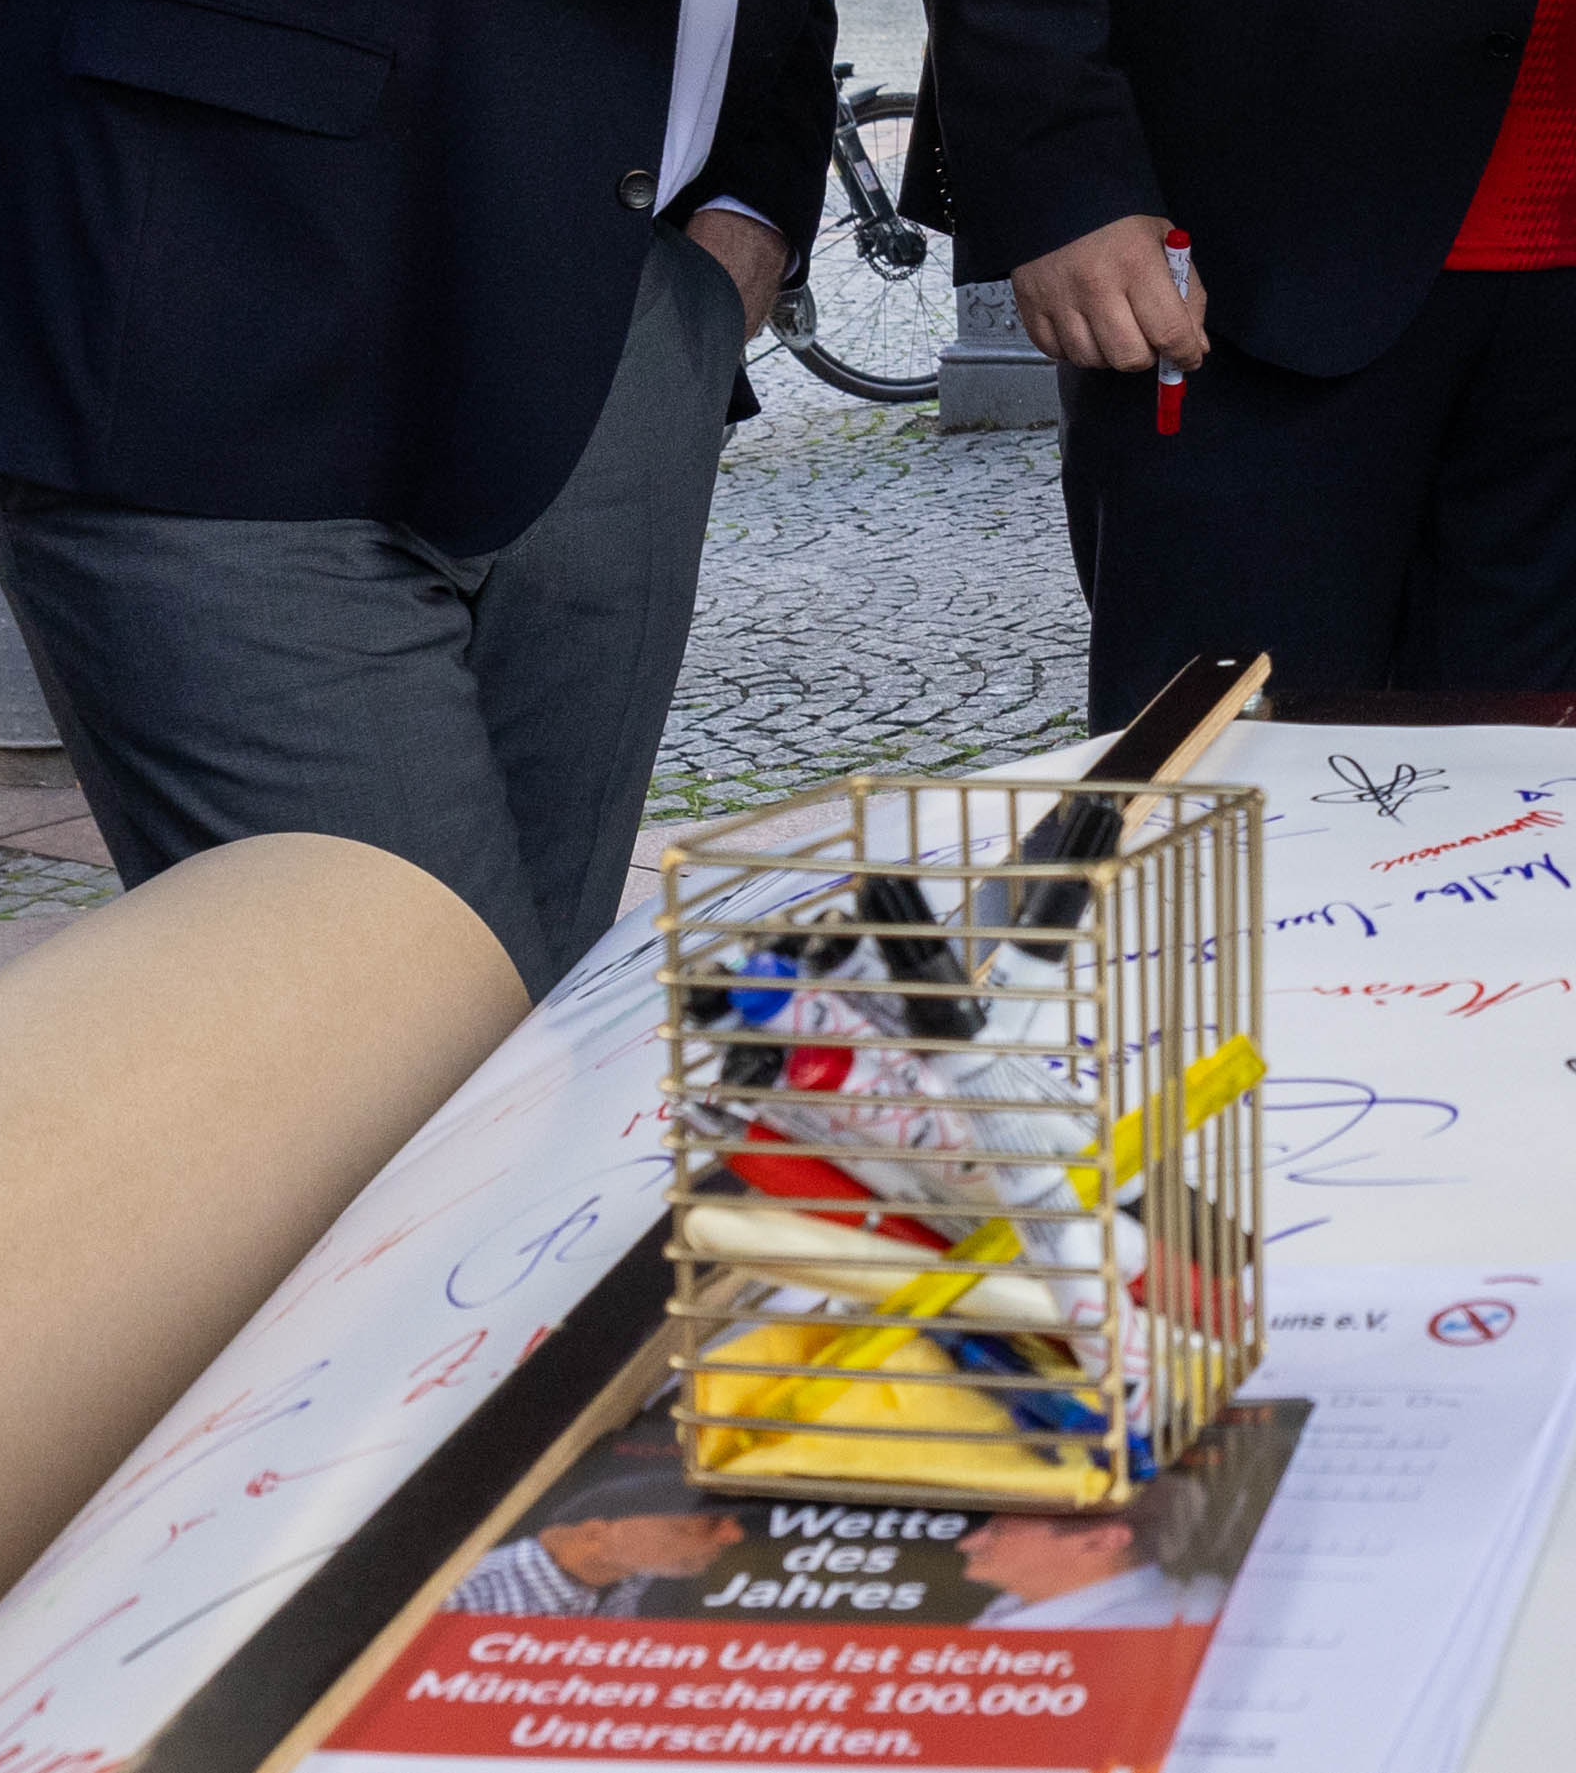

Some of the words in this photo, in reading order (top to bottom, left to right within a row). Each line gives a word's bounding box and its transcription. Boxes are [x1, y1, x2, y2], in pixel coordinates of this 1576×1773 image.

[769, 1506, 967, 1540] Wette
[782, 1538, 901, 1573] des
[702, 1572, 927, 1610] Jahres
[468, 1632, 708, 1671] Christian
[718, 1641, 823, 1673] Ude
[832, 1644, 900, 1674] ist
[906, 1644, 1074, 1678] sicher,
[406, 1669, 658, 1709] München
[664, 1675, 855, 1712] schafft
[864, 1683, 1087, 1717] 100.000
[509, 1714, 923, 1758] Unterschriften.
